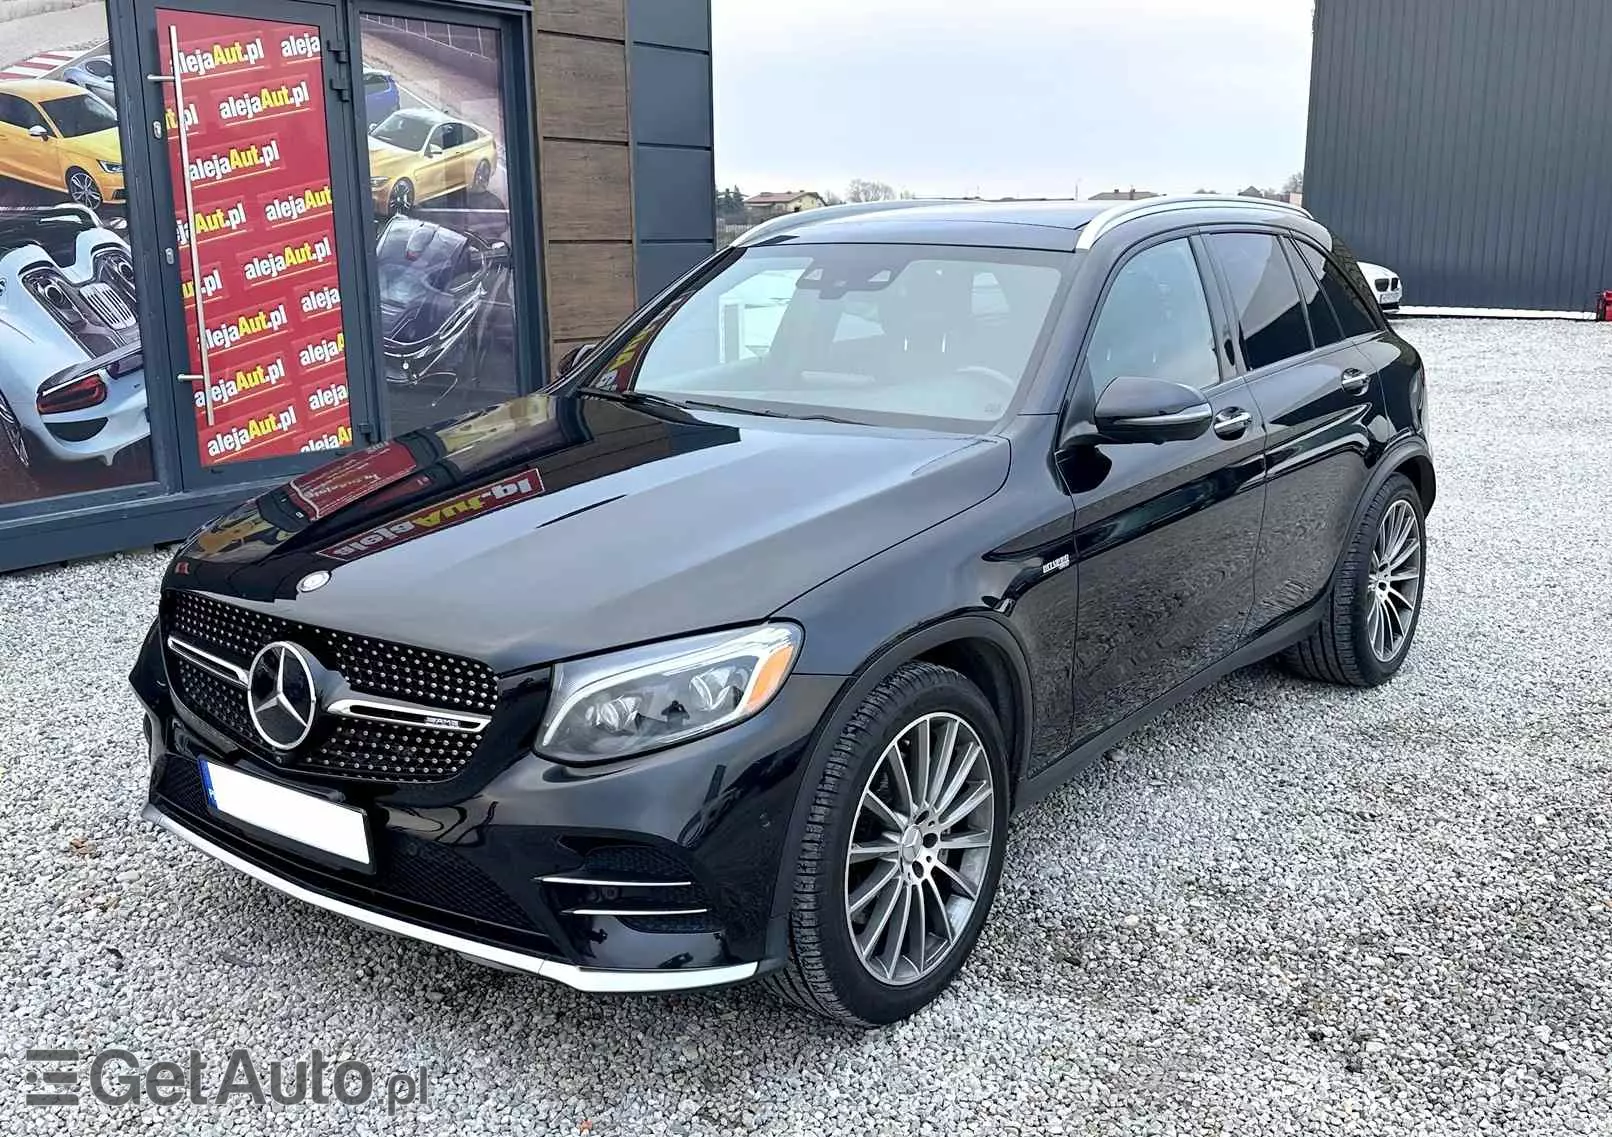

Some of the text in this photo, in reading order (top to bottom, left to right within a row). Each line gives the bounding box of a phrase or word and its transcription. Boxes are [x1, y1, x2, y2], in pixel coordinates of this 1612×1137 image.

[170, 38, 264, 75] lejaAut.pl
[219, 81, 310, 120] alejaAut.pl
[244, 236, 332, 281] alejaAut.pl
[197, 304, 288, 351] lejaAut.pl
[194, 358, 286, 408] aejaAut.pl
[207, 405, 297, 457] alejaAut.pl
